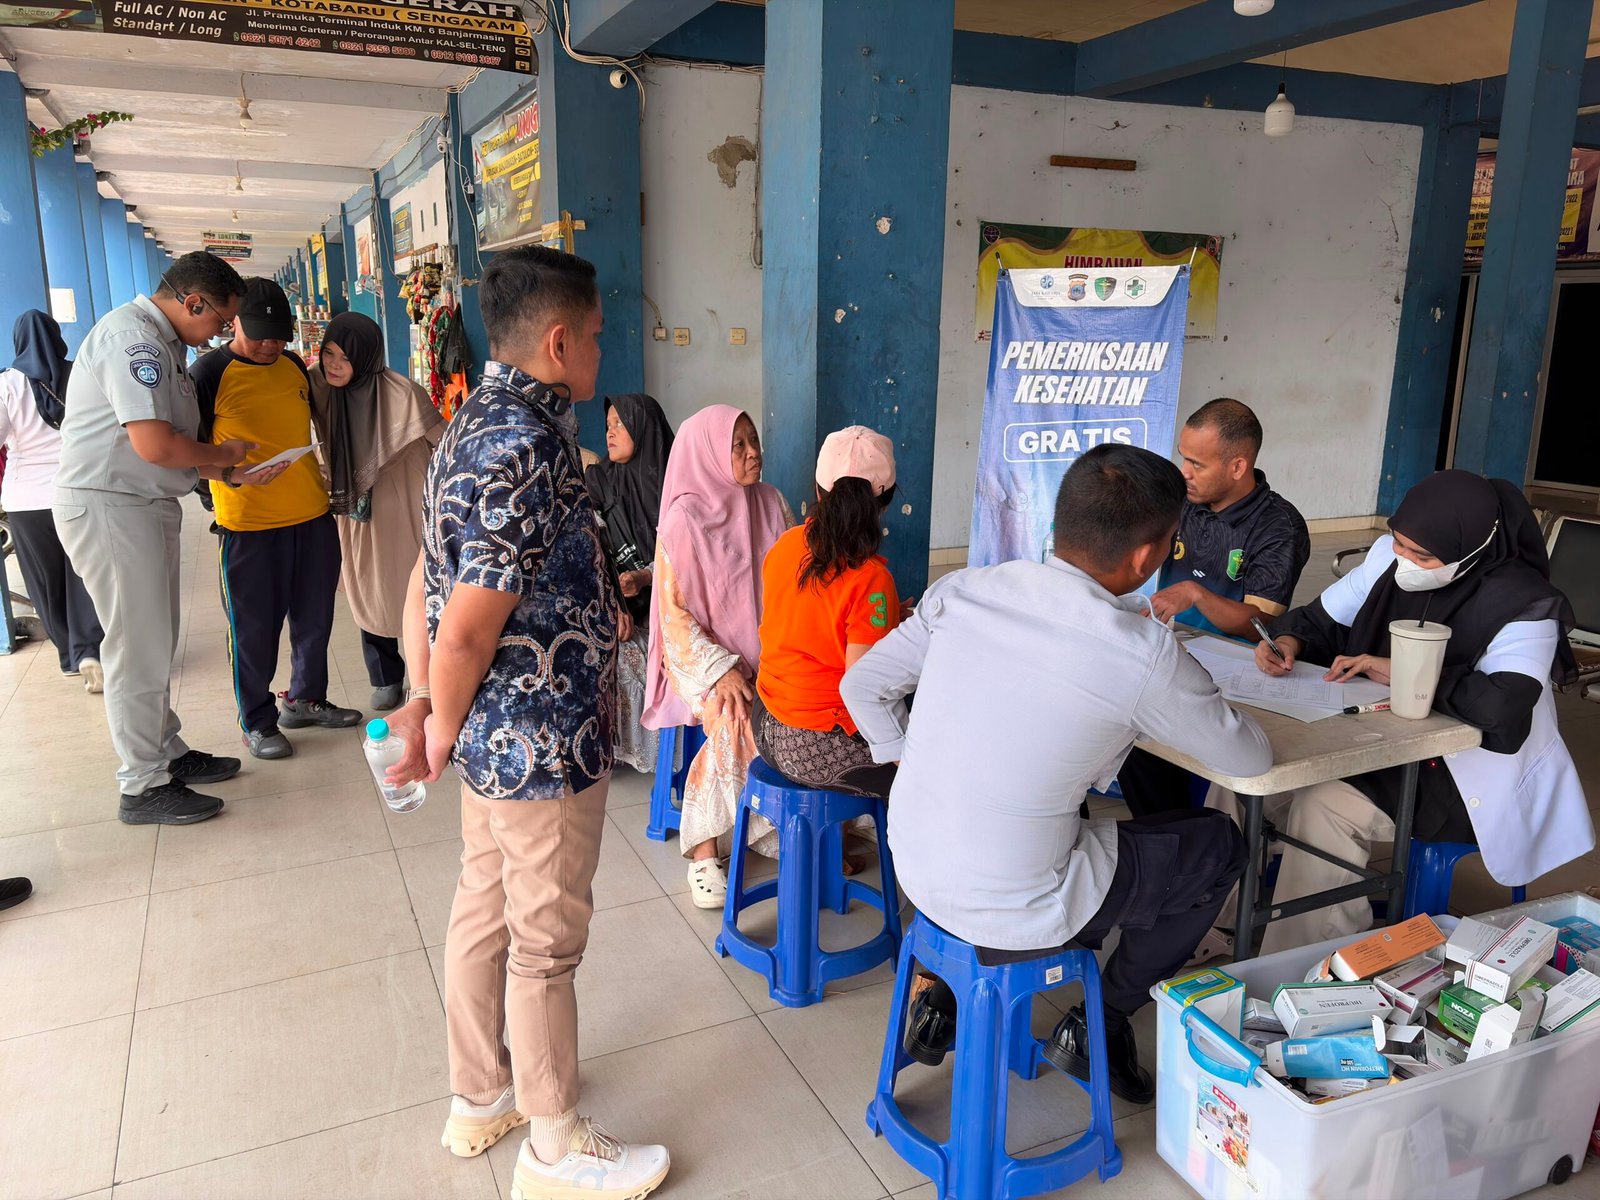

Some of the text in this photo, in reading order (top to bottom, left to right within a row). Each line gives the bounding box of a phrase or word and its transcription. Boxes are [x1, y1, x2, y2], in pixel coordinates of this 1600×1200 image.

[114, 1, 228, 21] Full AC / Non AC
[271, 0, 385, 17] KOTABARU
[407, 11, 515, 32] SENGAYAM
[113, 17, 223, 38] Standart / Long
[241, 32, 266, 42] 0821
[247, 21, 298, 32] Menerima
[300, 25, 343, 36] Carteran
[351, 30, 407, 43] Perorangan
[408, 36, 434, 46] Antar
[436, 39, 506, 53] KAL-SEL-TENG
[263, 11, 315, 22] Pramuka
[318, 15, 367, 27] Terminal
[371, 21, 401, 31] Induk
[404, 25, 425, 34] KM.
[438, 29, 504, 42] Banjarmasin
[339, 41, 364, 51] 0821
[1001, 341, 1170, 372] PEMERIKSAAN
[1013, 375, 1149, 406] KESEHATAN
[1018, 426, 1132, 454] GRATIS
[868, 592, 887, 627] 3
[1319, 1000, 1363, 1009] IBUPROFEN
[1451, 1002, 1475, 1020] NOZA
